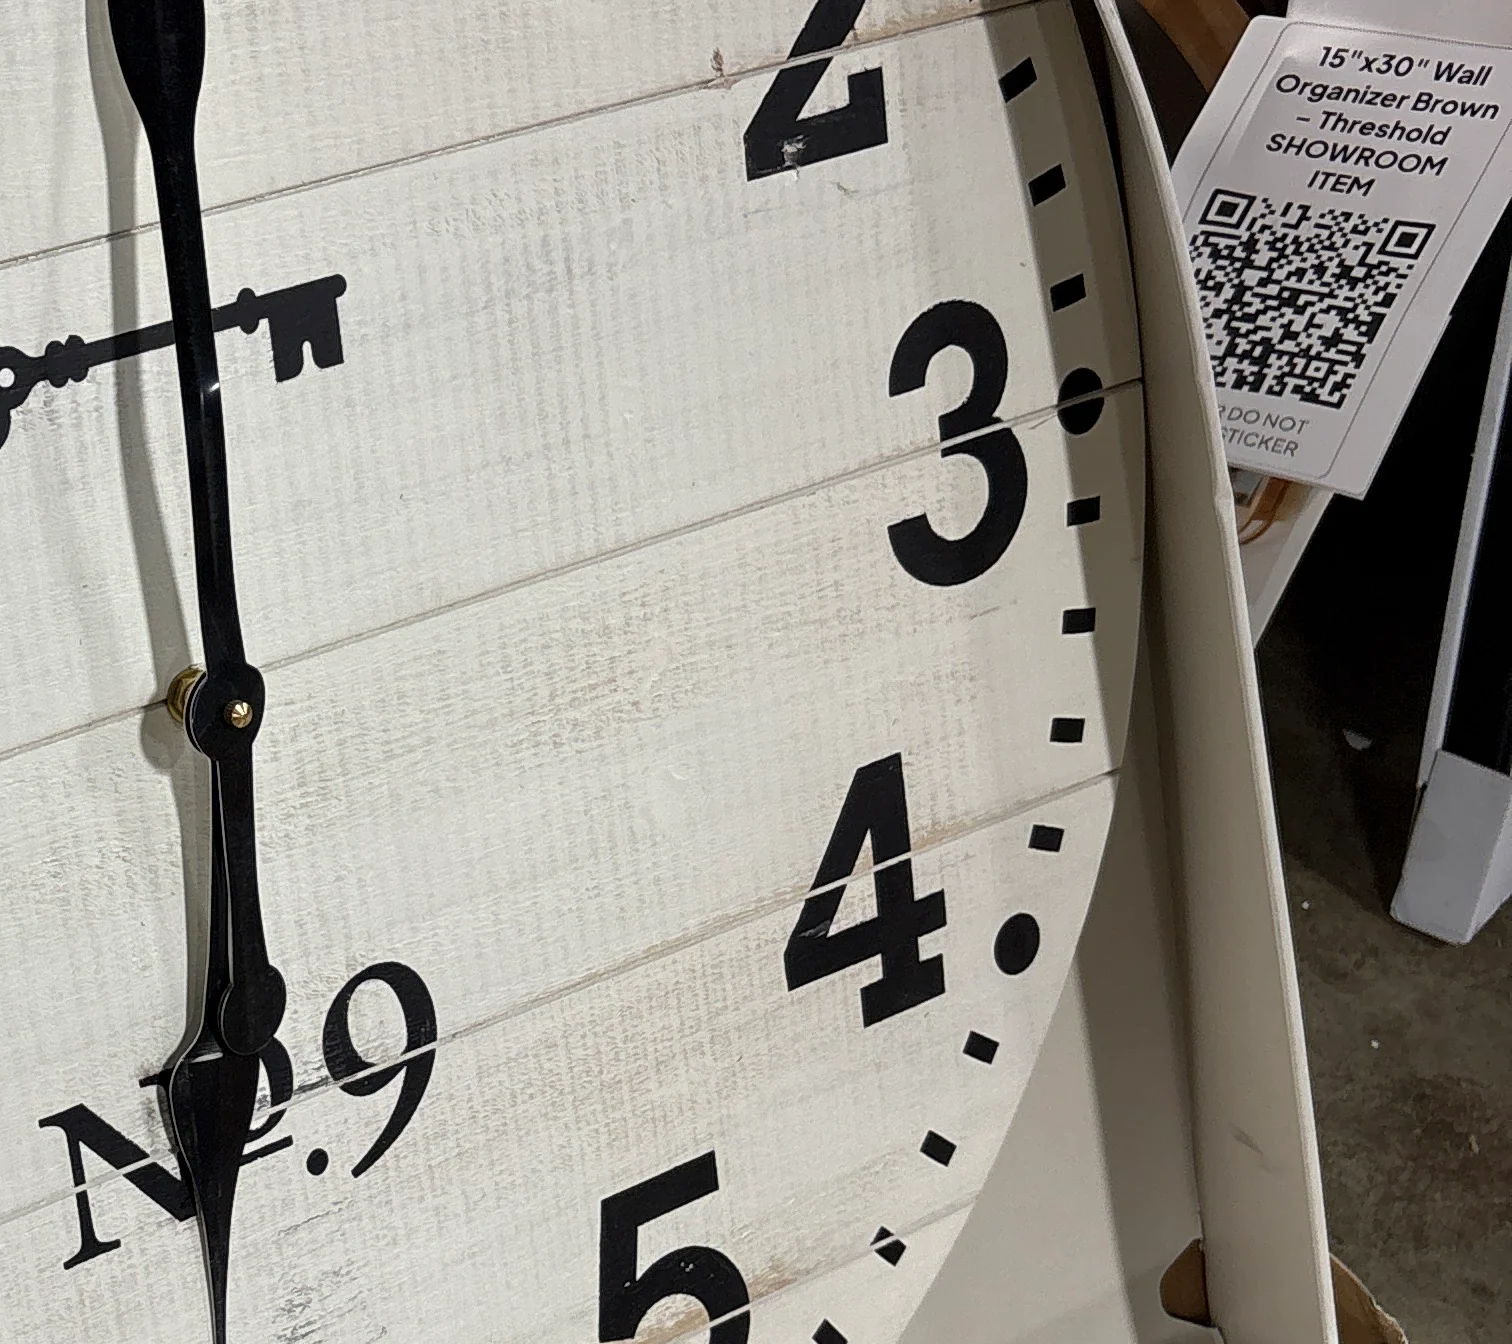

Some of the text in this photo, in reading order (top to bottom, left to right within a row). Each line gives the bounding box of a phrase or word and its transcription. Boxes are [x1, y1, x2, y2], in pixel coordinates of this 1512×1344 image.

[1318, 46, 1493, 86] 15"x30" Wall
[1276, 74, 1500, 119] Organizer Brown
[1319, 110, 1452, 145] Threshold
[1265, 133, 1449, 176] SHOWROOM
[1307, 170, 1376, 197] ITEM
[1227, 407, 1260, 424] DO
[1262, 413, 1309, 434] NOT
[888, 300, 1028, 586] 3
[784, 753, 947, 1027] 4
